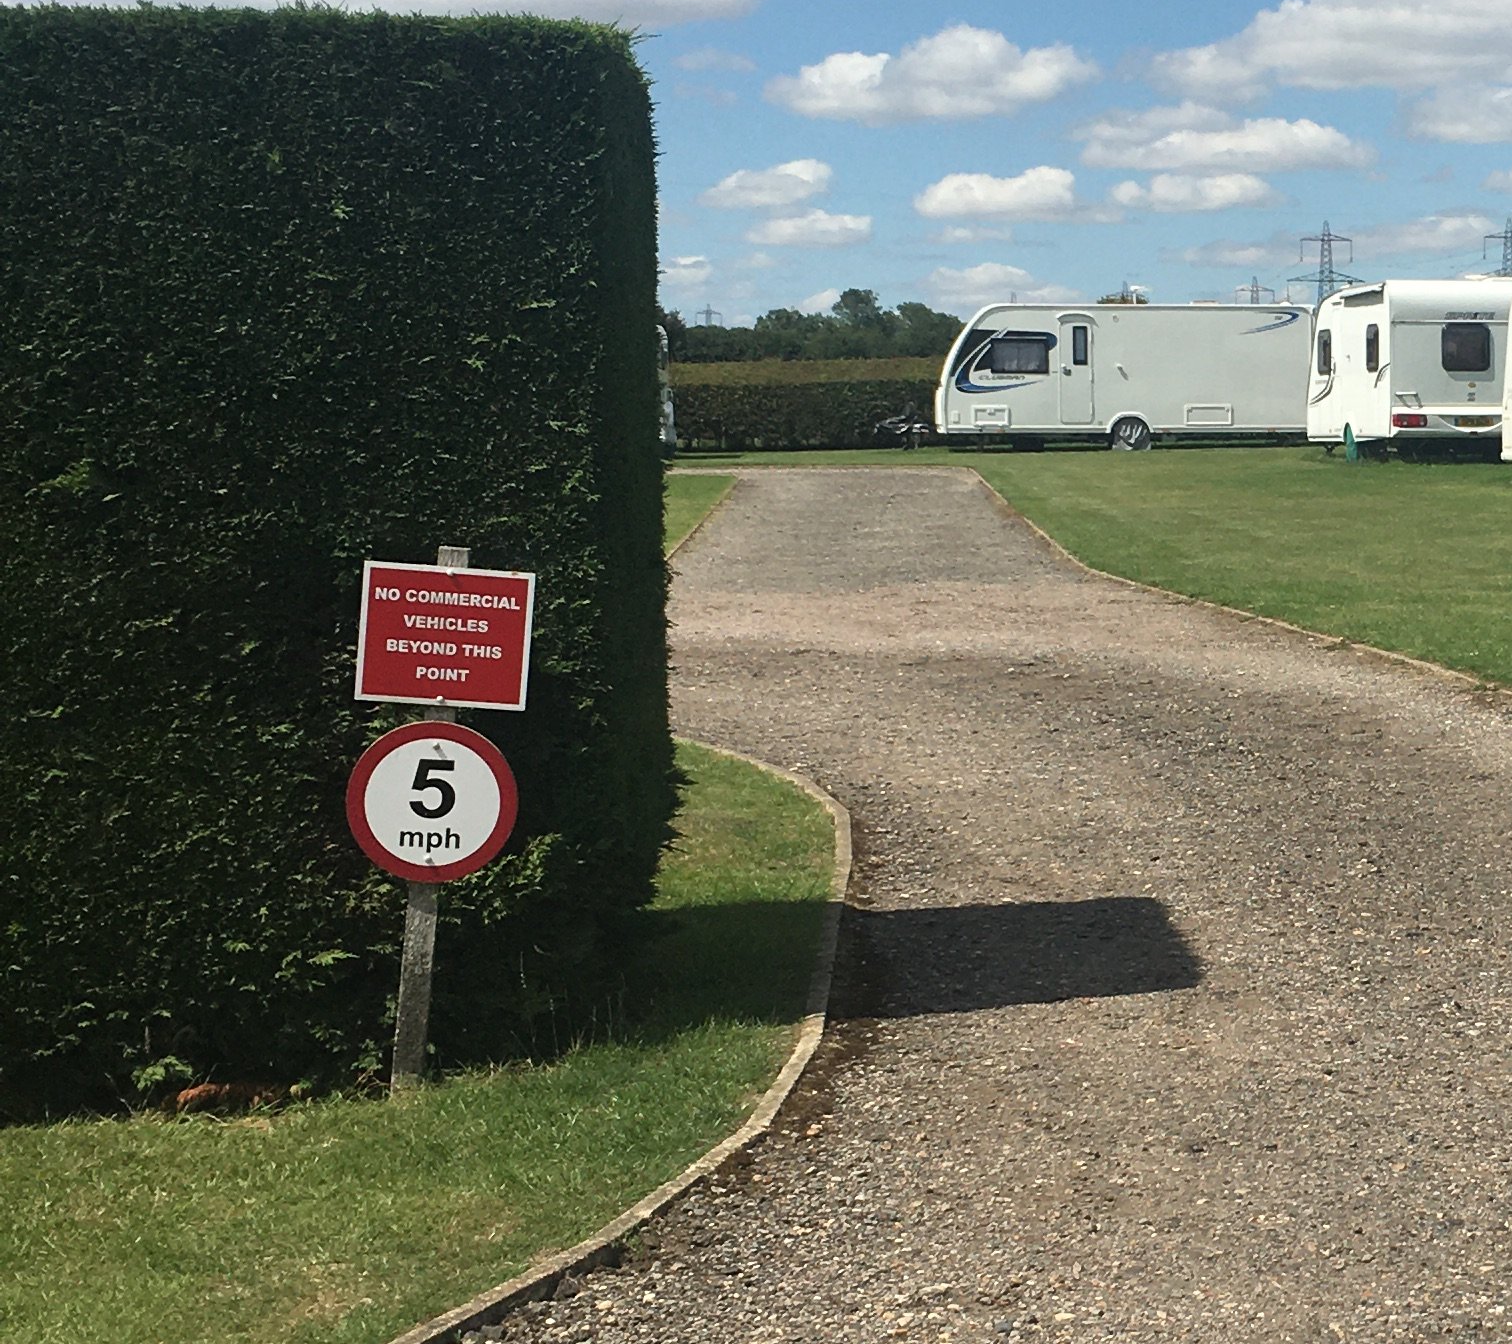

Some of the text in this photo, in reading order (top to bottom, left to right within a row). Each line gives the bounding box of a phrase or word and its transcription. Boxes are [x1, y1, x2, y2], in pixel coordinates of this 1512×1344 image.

[375, 587, 521, 610] NO COMMERCIAL
[403, 614, 489, 633] VEHICLES
[386, 639, 502, 659] BEYOND THIS
[416, 667, 469, 682] POINT
[408, 758, 456, 819] 5
[399, 827, 461, 853] mph
